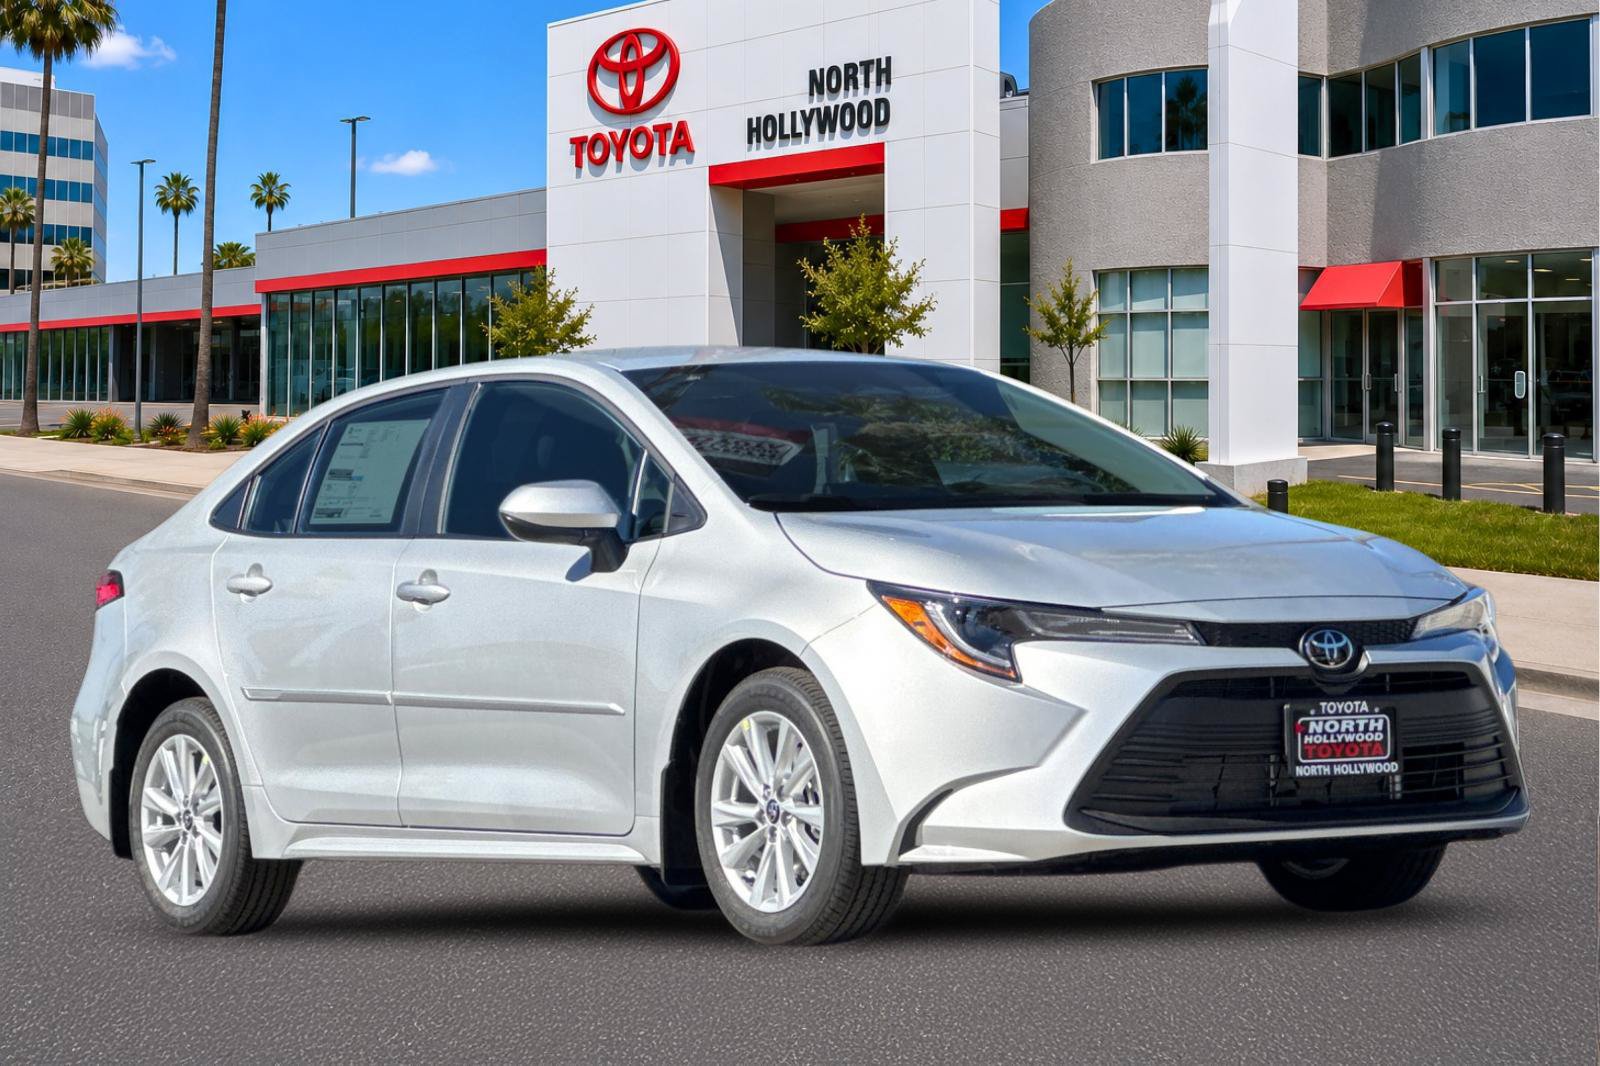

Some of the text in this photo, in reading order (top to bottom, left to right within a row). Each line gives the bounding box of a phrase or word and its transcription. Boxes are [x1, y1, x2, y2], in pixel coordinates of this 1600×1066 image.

[808, 55, 892, 97] NORTH
[747, 97, 891, 145] HOLLYWOOD
[569, 120, 695, 169] TOYOTA
[1320, 701, 1369, 714] TOYOTA
[1308, 719, 1384, 734] NORTH
[1303, 732, 1384, 744] HOLLYWOOD
[1303, 742, 1384, 758] TOYOTA
[1295, 762, 1399, 777] NORTH HOLLYWOOD
